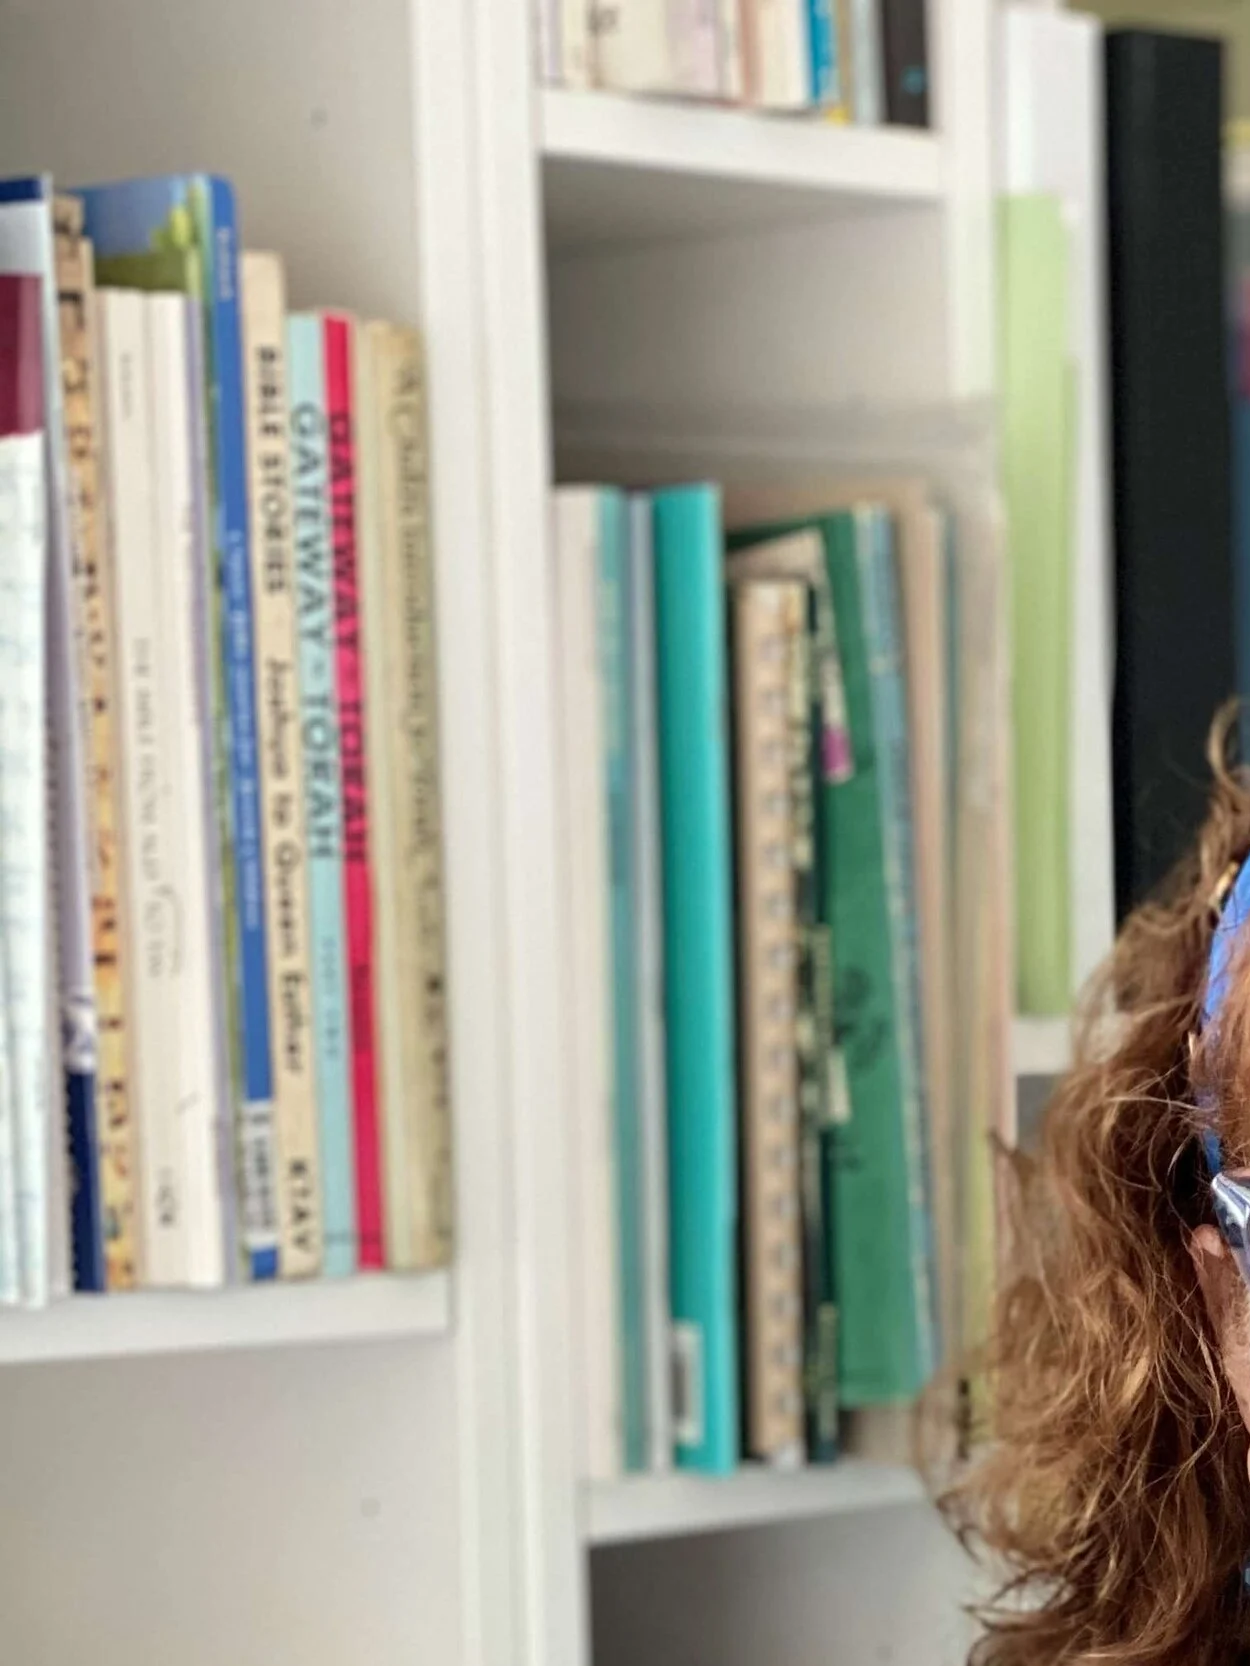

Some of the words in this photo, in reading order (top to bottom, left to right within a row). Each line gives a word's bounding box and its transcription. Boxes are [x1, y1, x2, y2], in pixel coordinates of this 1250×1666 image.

[259, 347, 282, 436] BIBLE
[260, 455, 288, 595] STORIES
[291, 403, 329, 641] GATEWAY
[329, 410, 360, 650] GATEWAY
[266, 659, 294, 782] Joshua
[302, 696, 337, 858] TORAH
[340, 701, 366, 860] TORAH
[274, 838, 299, 968] Queen
[282, 972, 307, 1074] Esther
[288, 1157, 314, 1255] KTAV
